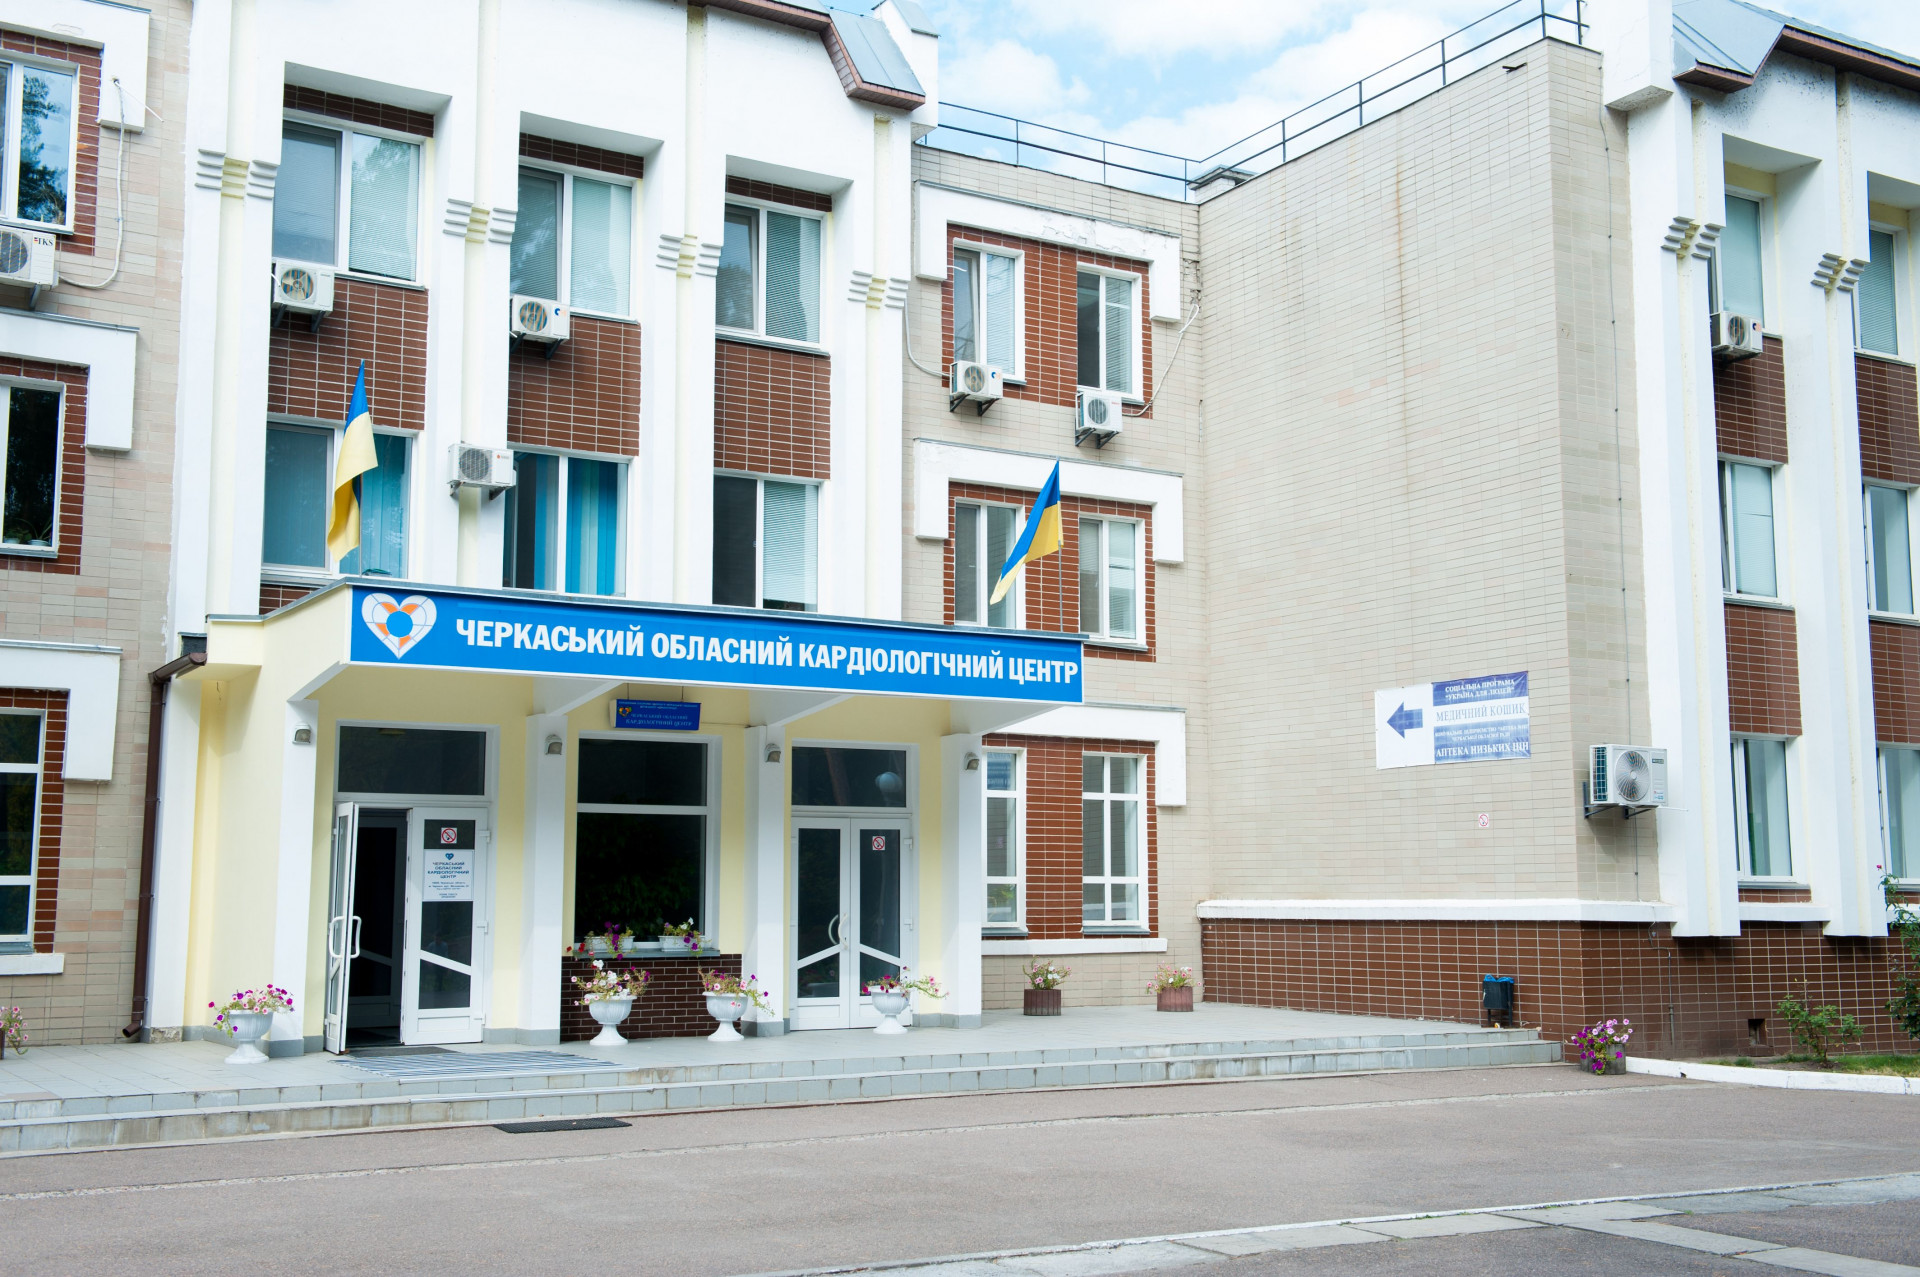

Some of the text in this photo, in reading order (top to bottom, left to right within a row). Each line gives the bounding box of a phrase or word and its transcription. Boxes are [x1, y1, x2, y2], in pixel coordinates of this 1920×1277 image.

[456, 619, 1079, 685] ЧЕРКАСЬКИЙ ОБЛАСНИЙ КАРДІОЛОГІЧНИЙ ЦЕНТР
[1445, 679, 1515, 693] СОЦІАЛЬНА ПРОГРАМА
[1436, 703, 1526, 721] МЕДИЧНИЙ КОШИК
[1436, 746, 1469, 757] АПТЕКА
[1470, 742, 1511, 755] НИЗЬКИХ
